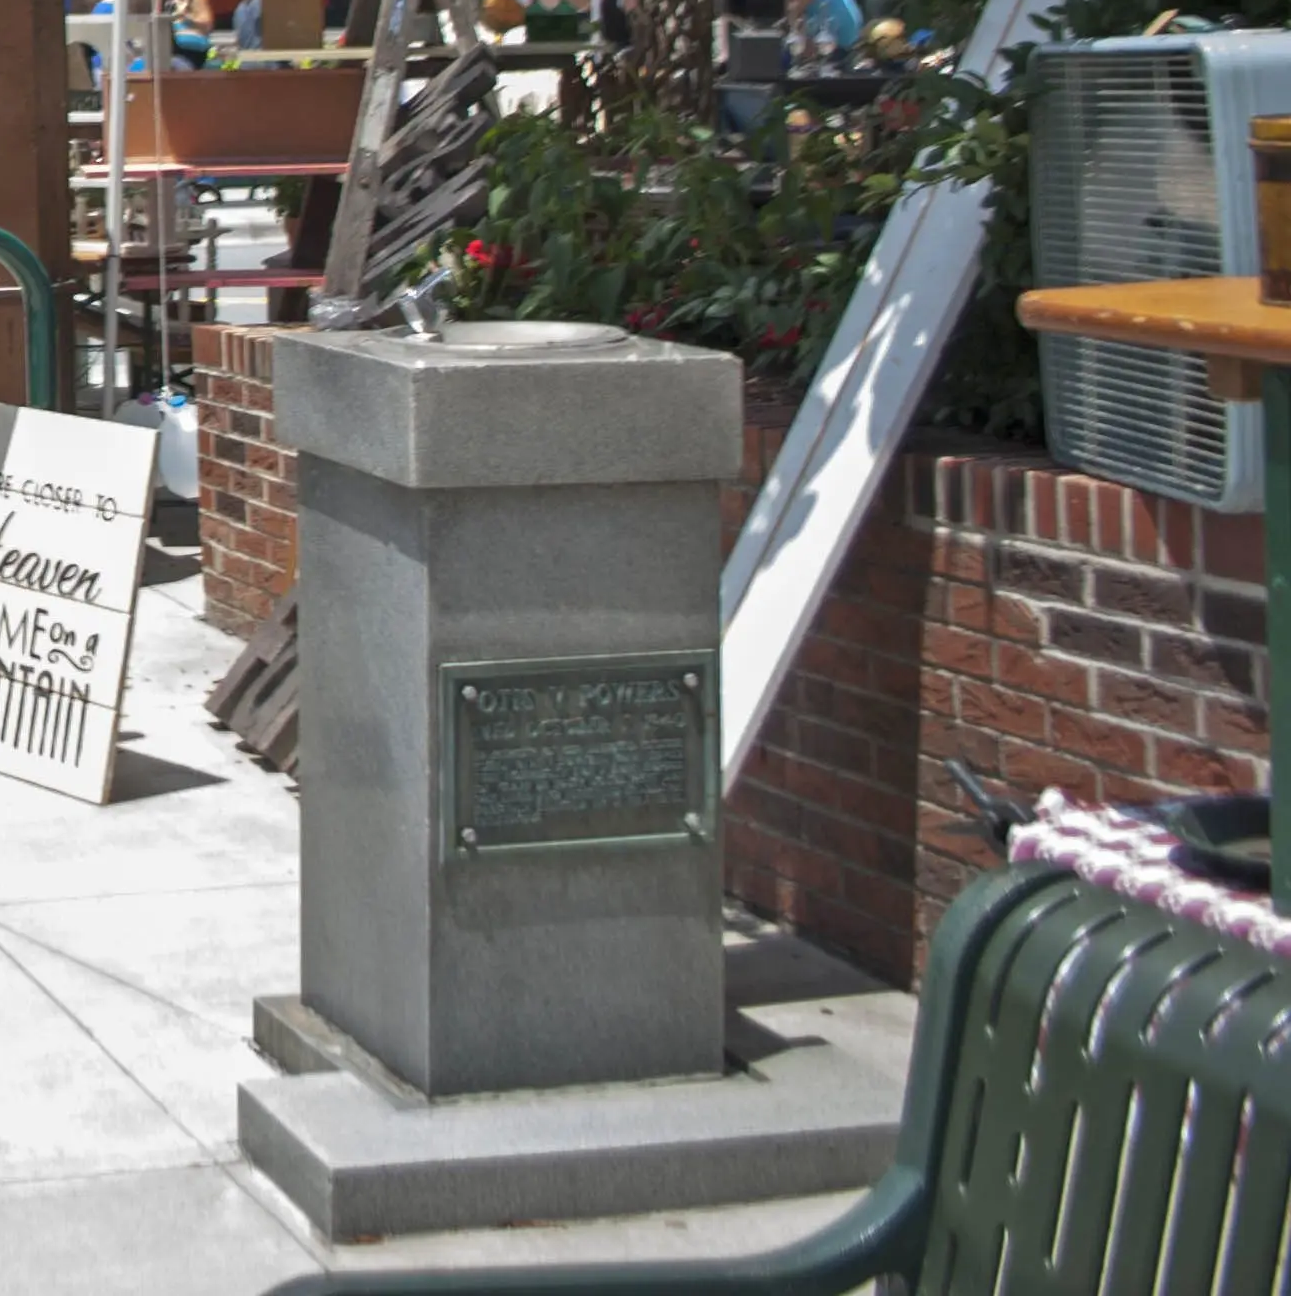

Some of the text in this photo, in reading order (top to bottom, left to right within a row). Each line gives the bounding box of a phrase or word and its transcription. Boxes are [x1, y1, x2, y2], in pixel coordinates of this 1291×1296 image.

[21, 479, 84, 514] CLOSER
[95, 493, 118, 521] TO
[50, 622, 76, 647] on
[86, 632, 100, 655] a
[579, 679, 680, 708] POWERS
